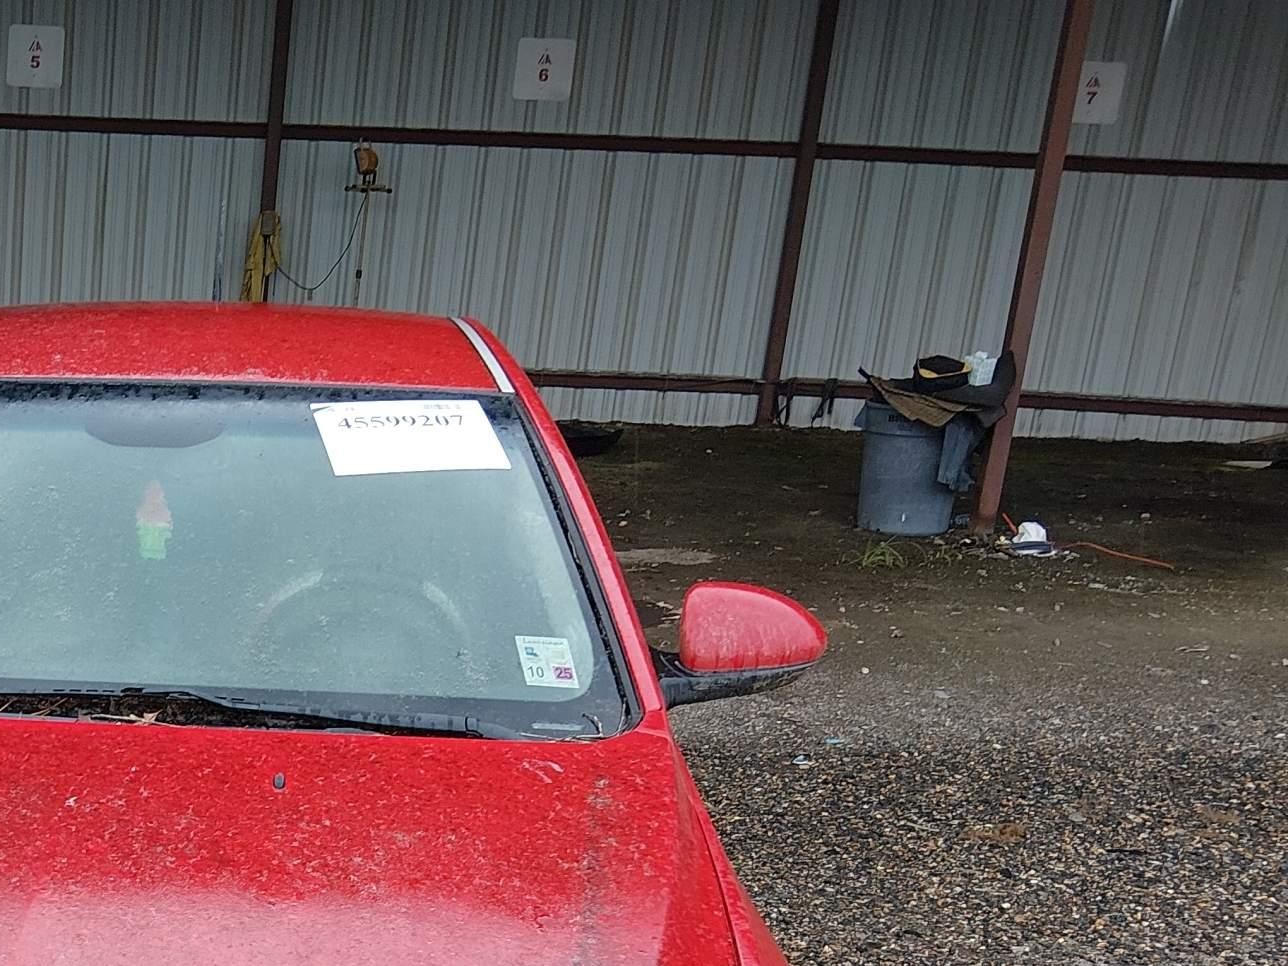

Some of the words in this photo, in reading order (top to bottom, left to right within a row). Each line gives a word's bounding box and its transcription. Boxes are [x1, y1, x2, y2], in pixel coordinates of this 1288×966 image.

[30, 55, 41, 68] 5
[539, 68, 549, 82] 6
[1087, 91, 1098, 104] 7
[337, 414, 463, 429] 45599207
[527, 665, 544, 678] 10
[554, 666, 573, 680] 25
